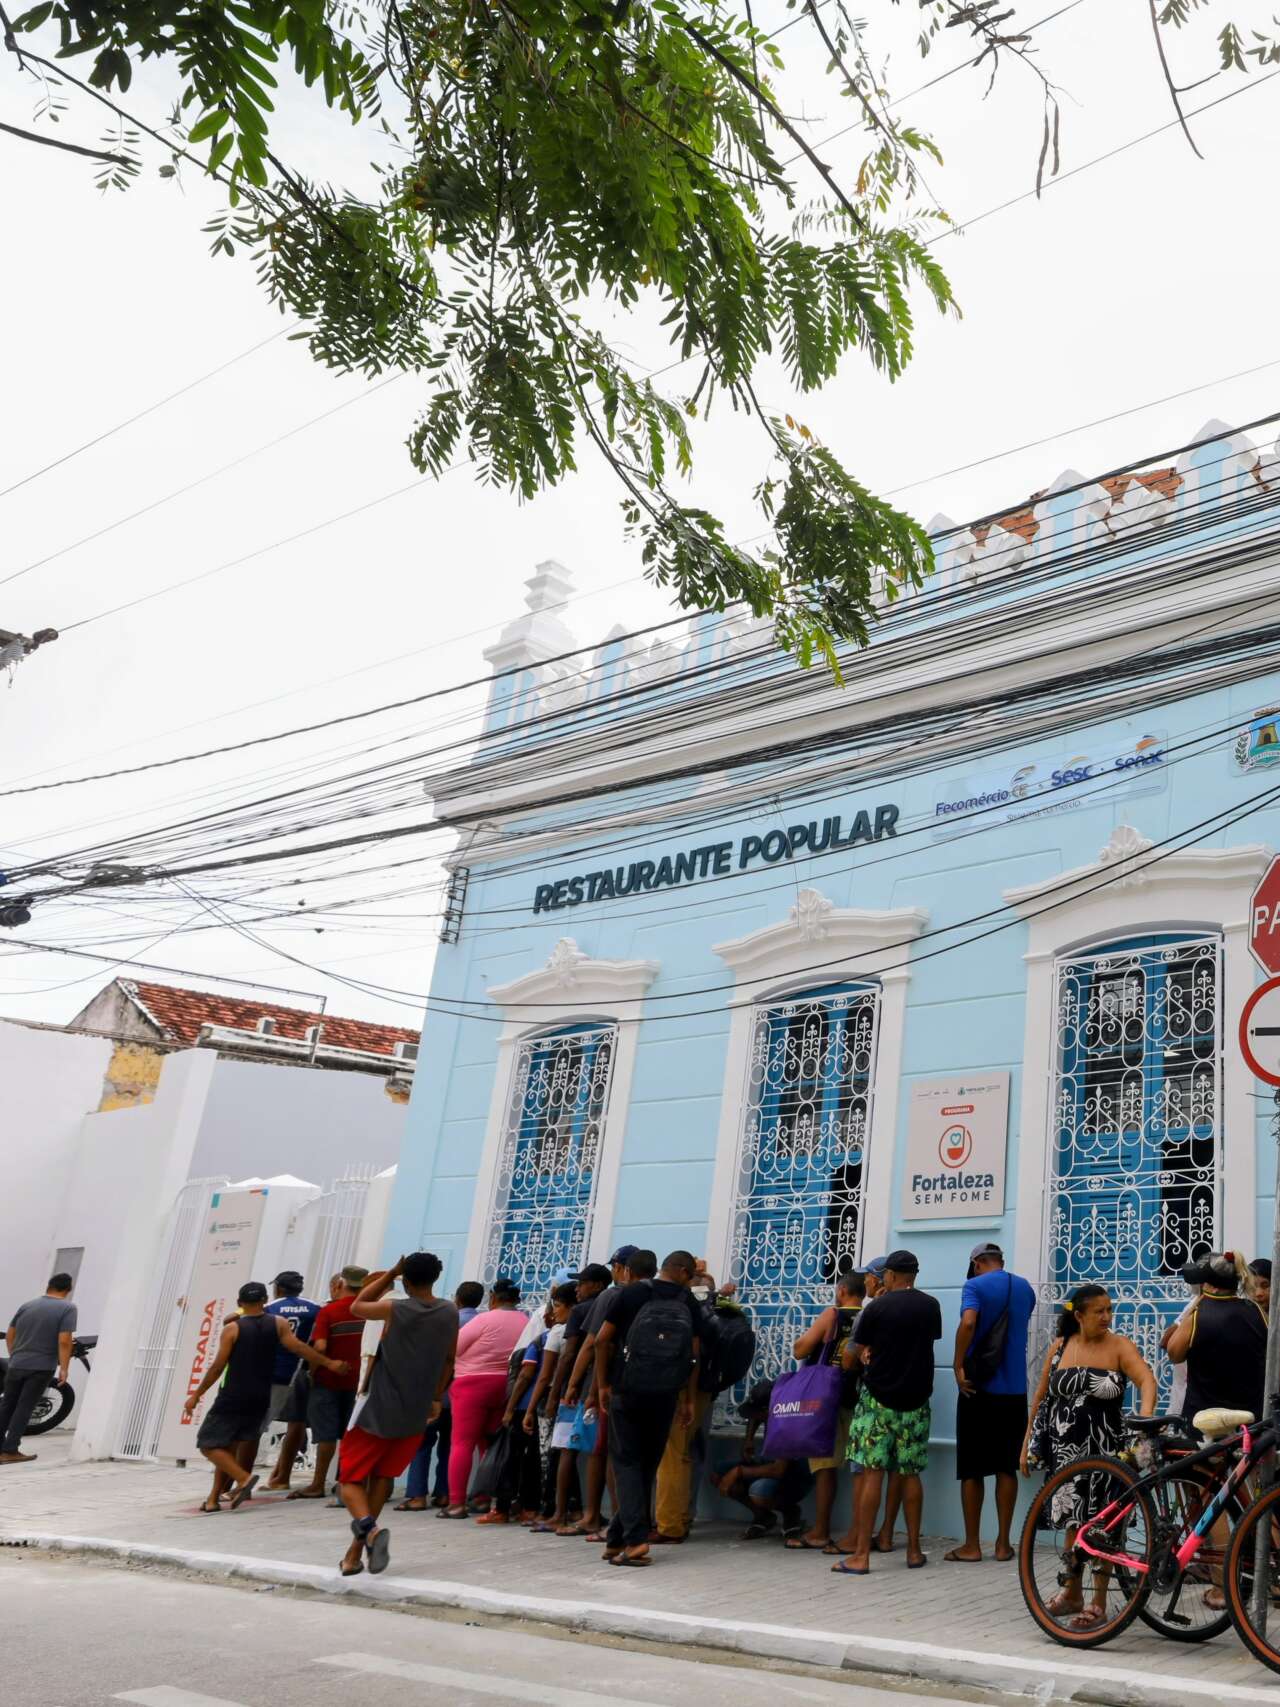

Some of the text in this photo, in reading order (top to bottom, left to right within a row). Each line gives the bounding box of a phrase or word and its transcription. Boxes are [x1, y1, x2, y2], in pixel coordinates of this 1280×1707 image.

[935, 789, 1009, 816] Fecomércio
[1051, 765, 1094, 787] Sesc
[532, 803, 900, 913] RESTAURANTE POPULAR
[912, 1172, 994, 1192] Fortaleza
[915, 1190, 990, 1205] SEM FOME
